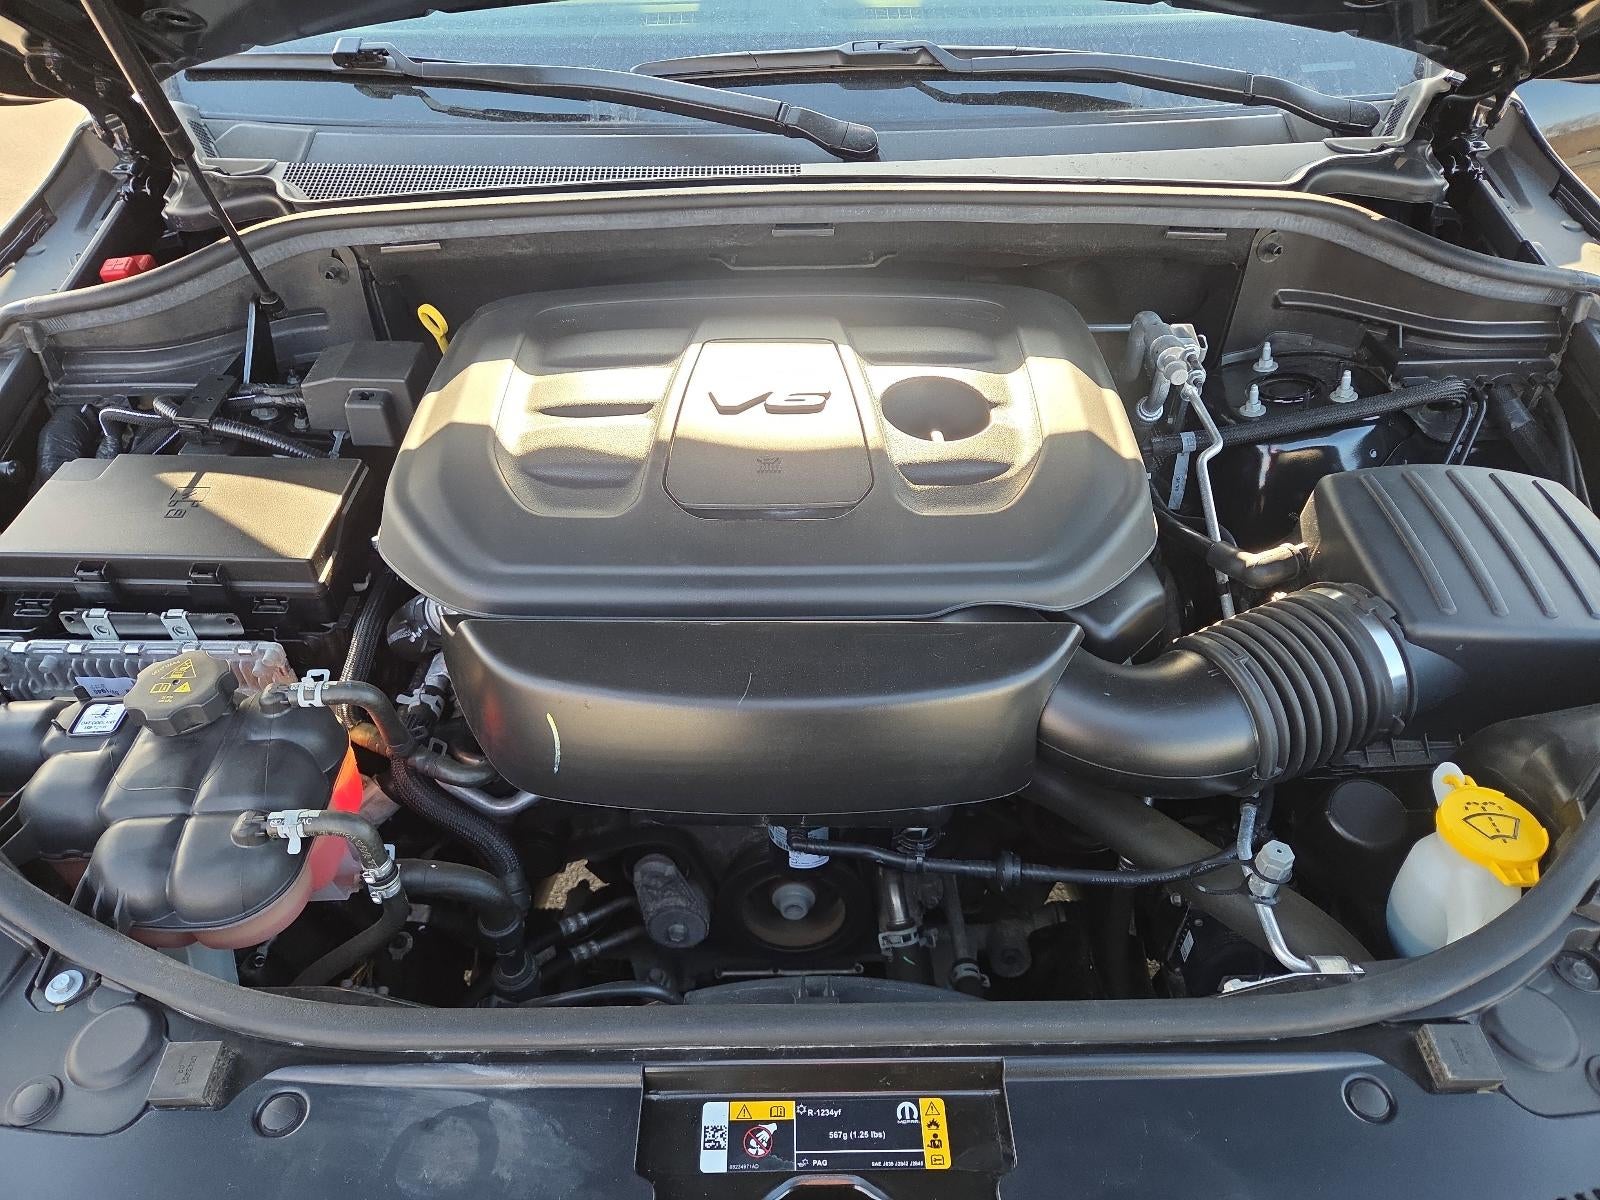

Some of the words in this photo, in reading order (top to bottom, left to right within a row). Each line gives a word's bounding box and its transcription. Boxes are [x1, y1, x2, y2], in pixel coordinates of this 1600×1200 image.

[707, 389, 832, 415] V6
[807, 1108, 842, 1118] R-1234yf
[828, 1130, 848, 1141] 567g
[849, 1130, 870, 1140] (1.25
[870, 1130, 886, 1140] lbs)
[812, 1159, 828, 1167] PAG
